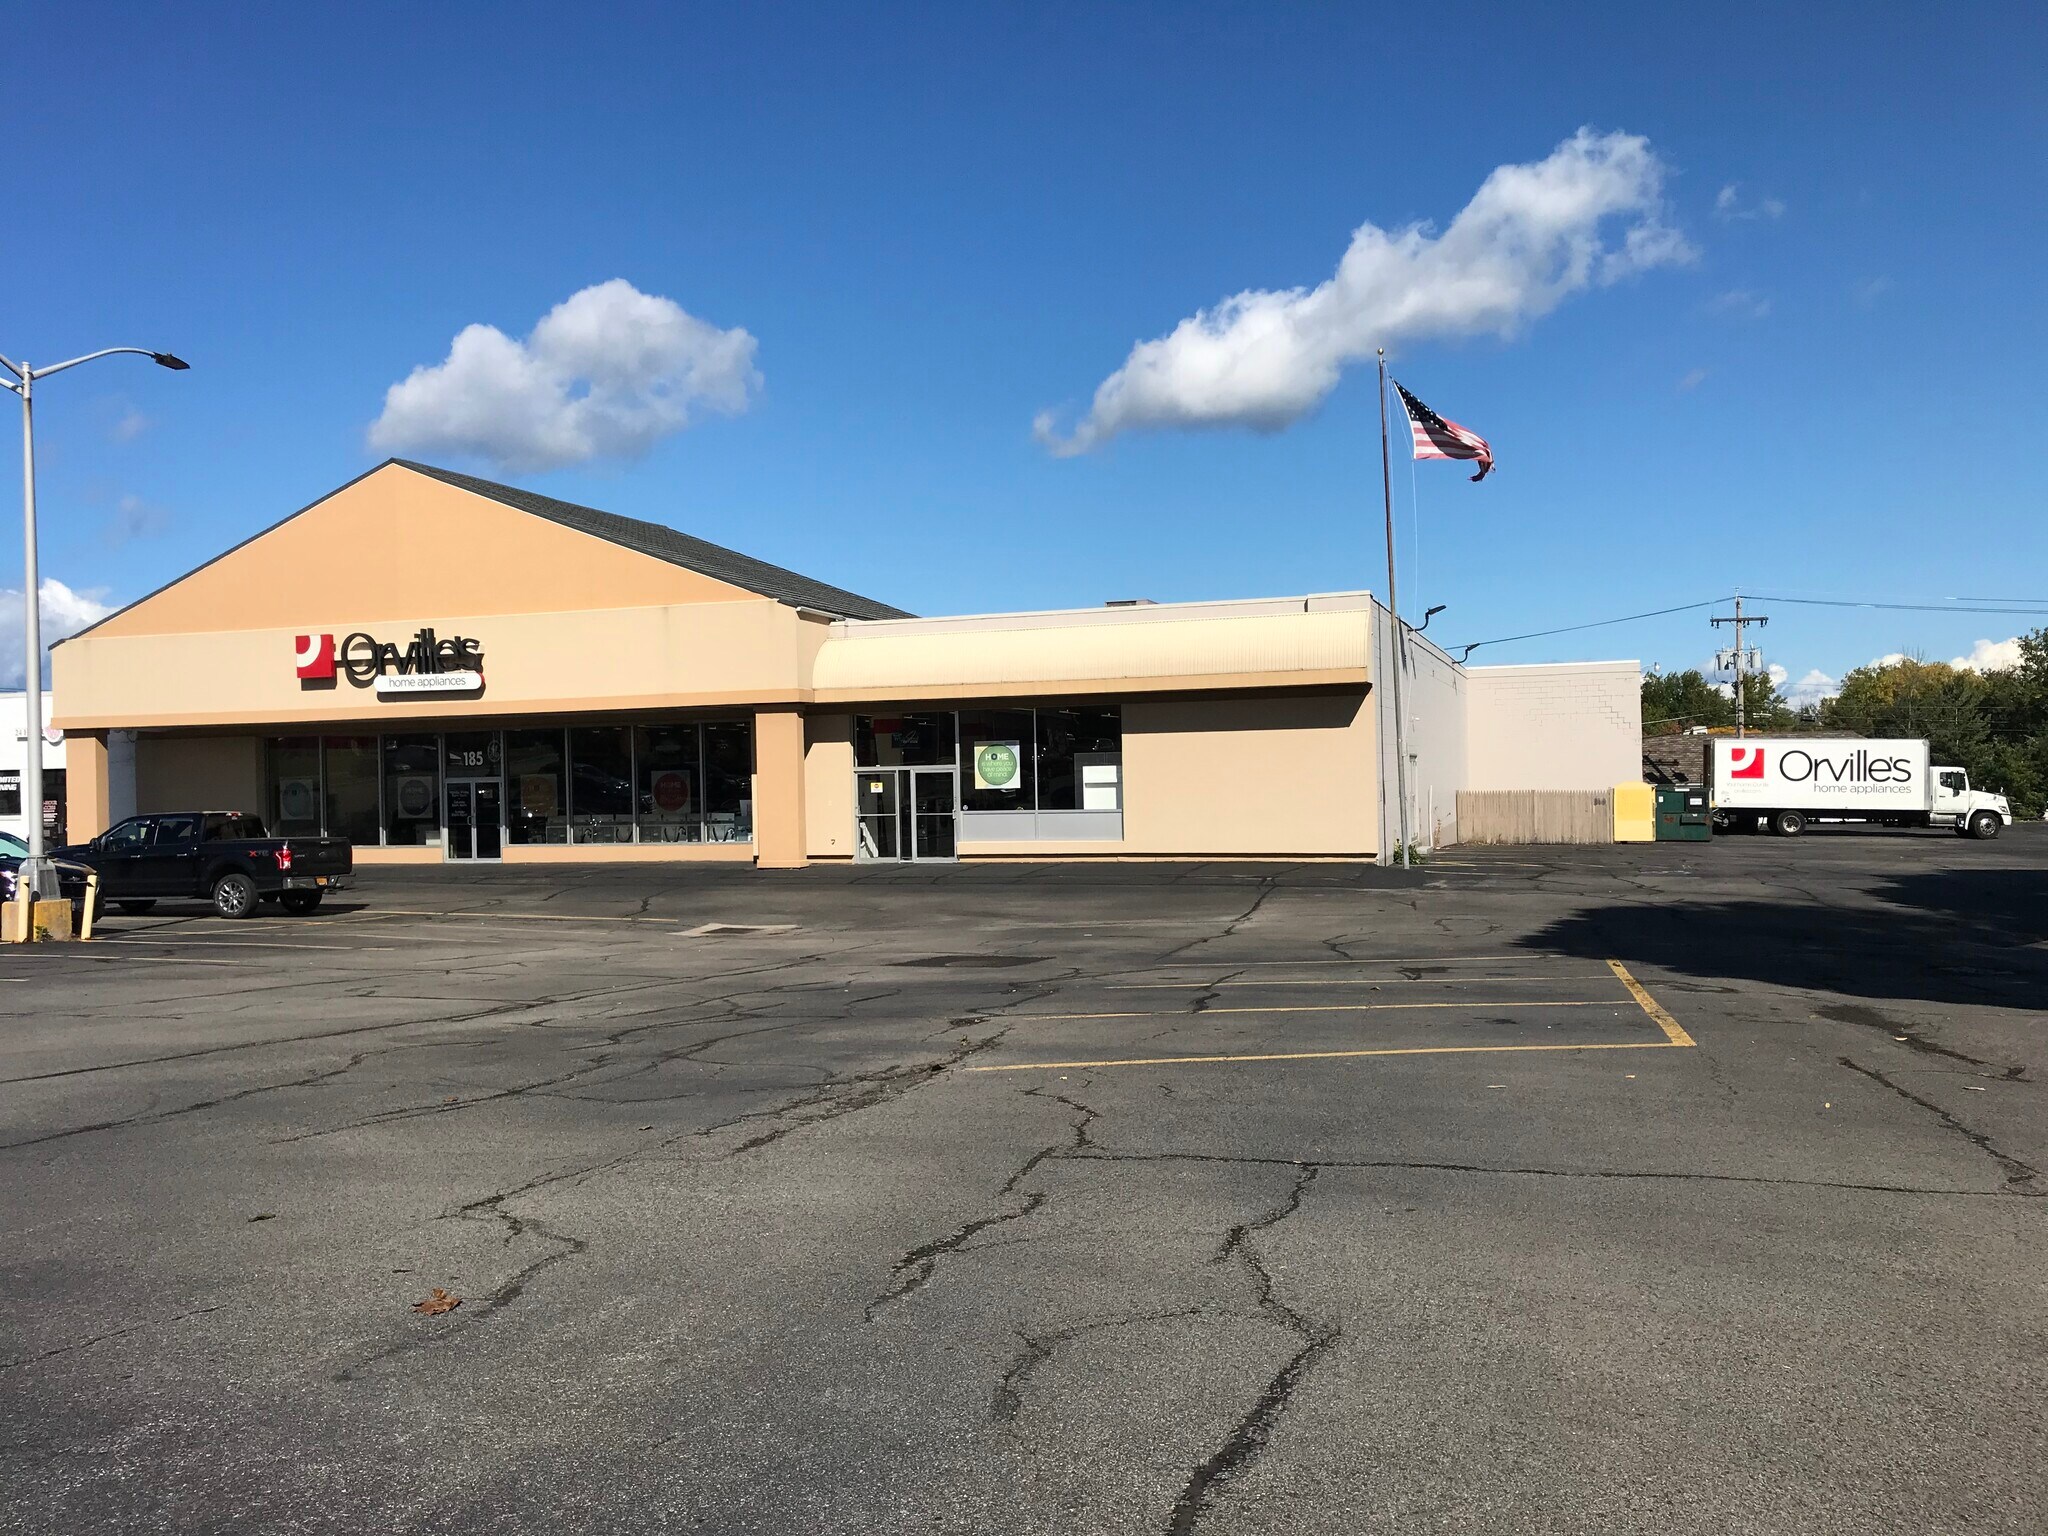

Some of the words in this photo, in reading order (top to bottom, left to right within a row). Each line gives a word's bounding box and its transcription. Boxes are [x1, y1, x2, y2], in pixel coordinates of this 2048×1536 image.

[341, 628, 481, 675] Orville's
[388, 677, 416, 687] home
[417, 676, 467, 688] appliances
[463, 751, 484, 766] 185
[1779, 749, 1912, 783] Orville's
[1813, 783, 1847, 793] home
[1849, 784, 1912, 795] appliances
